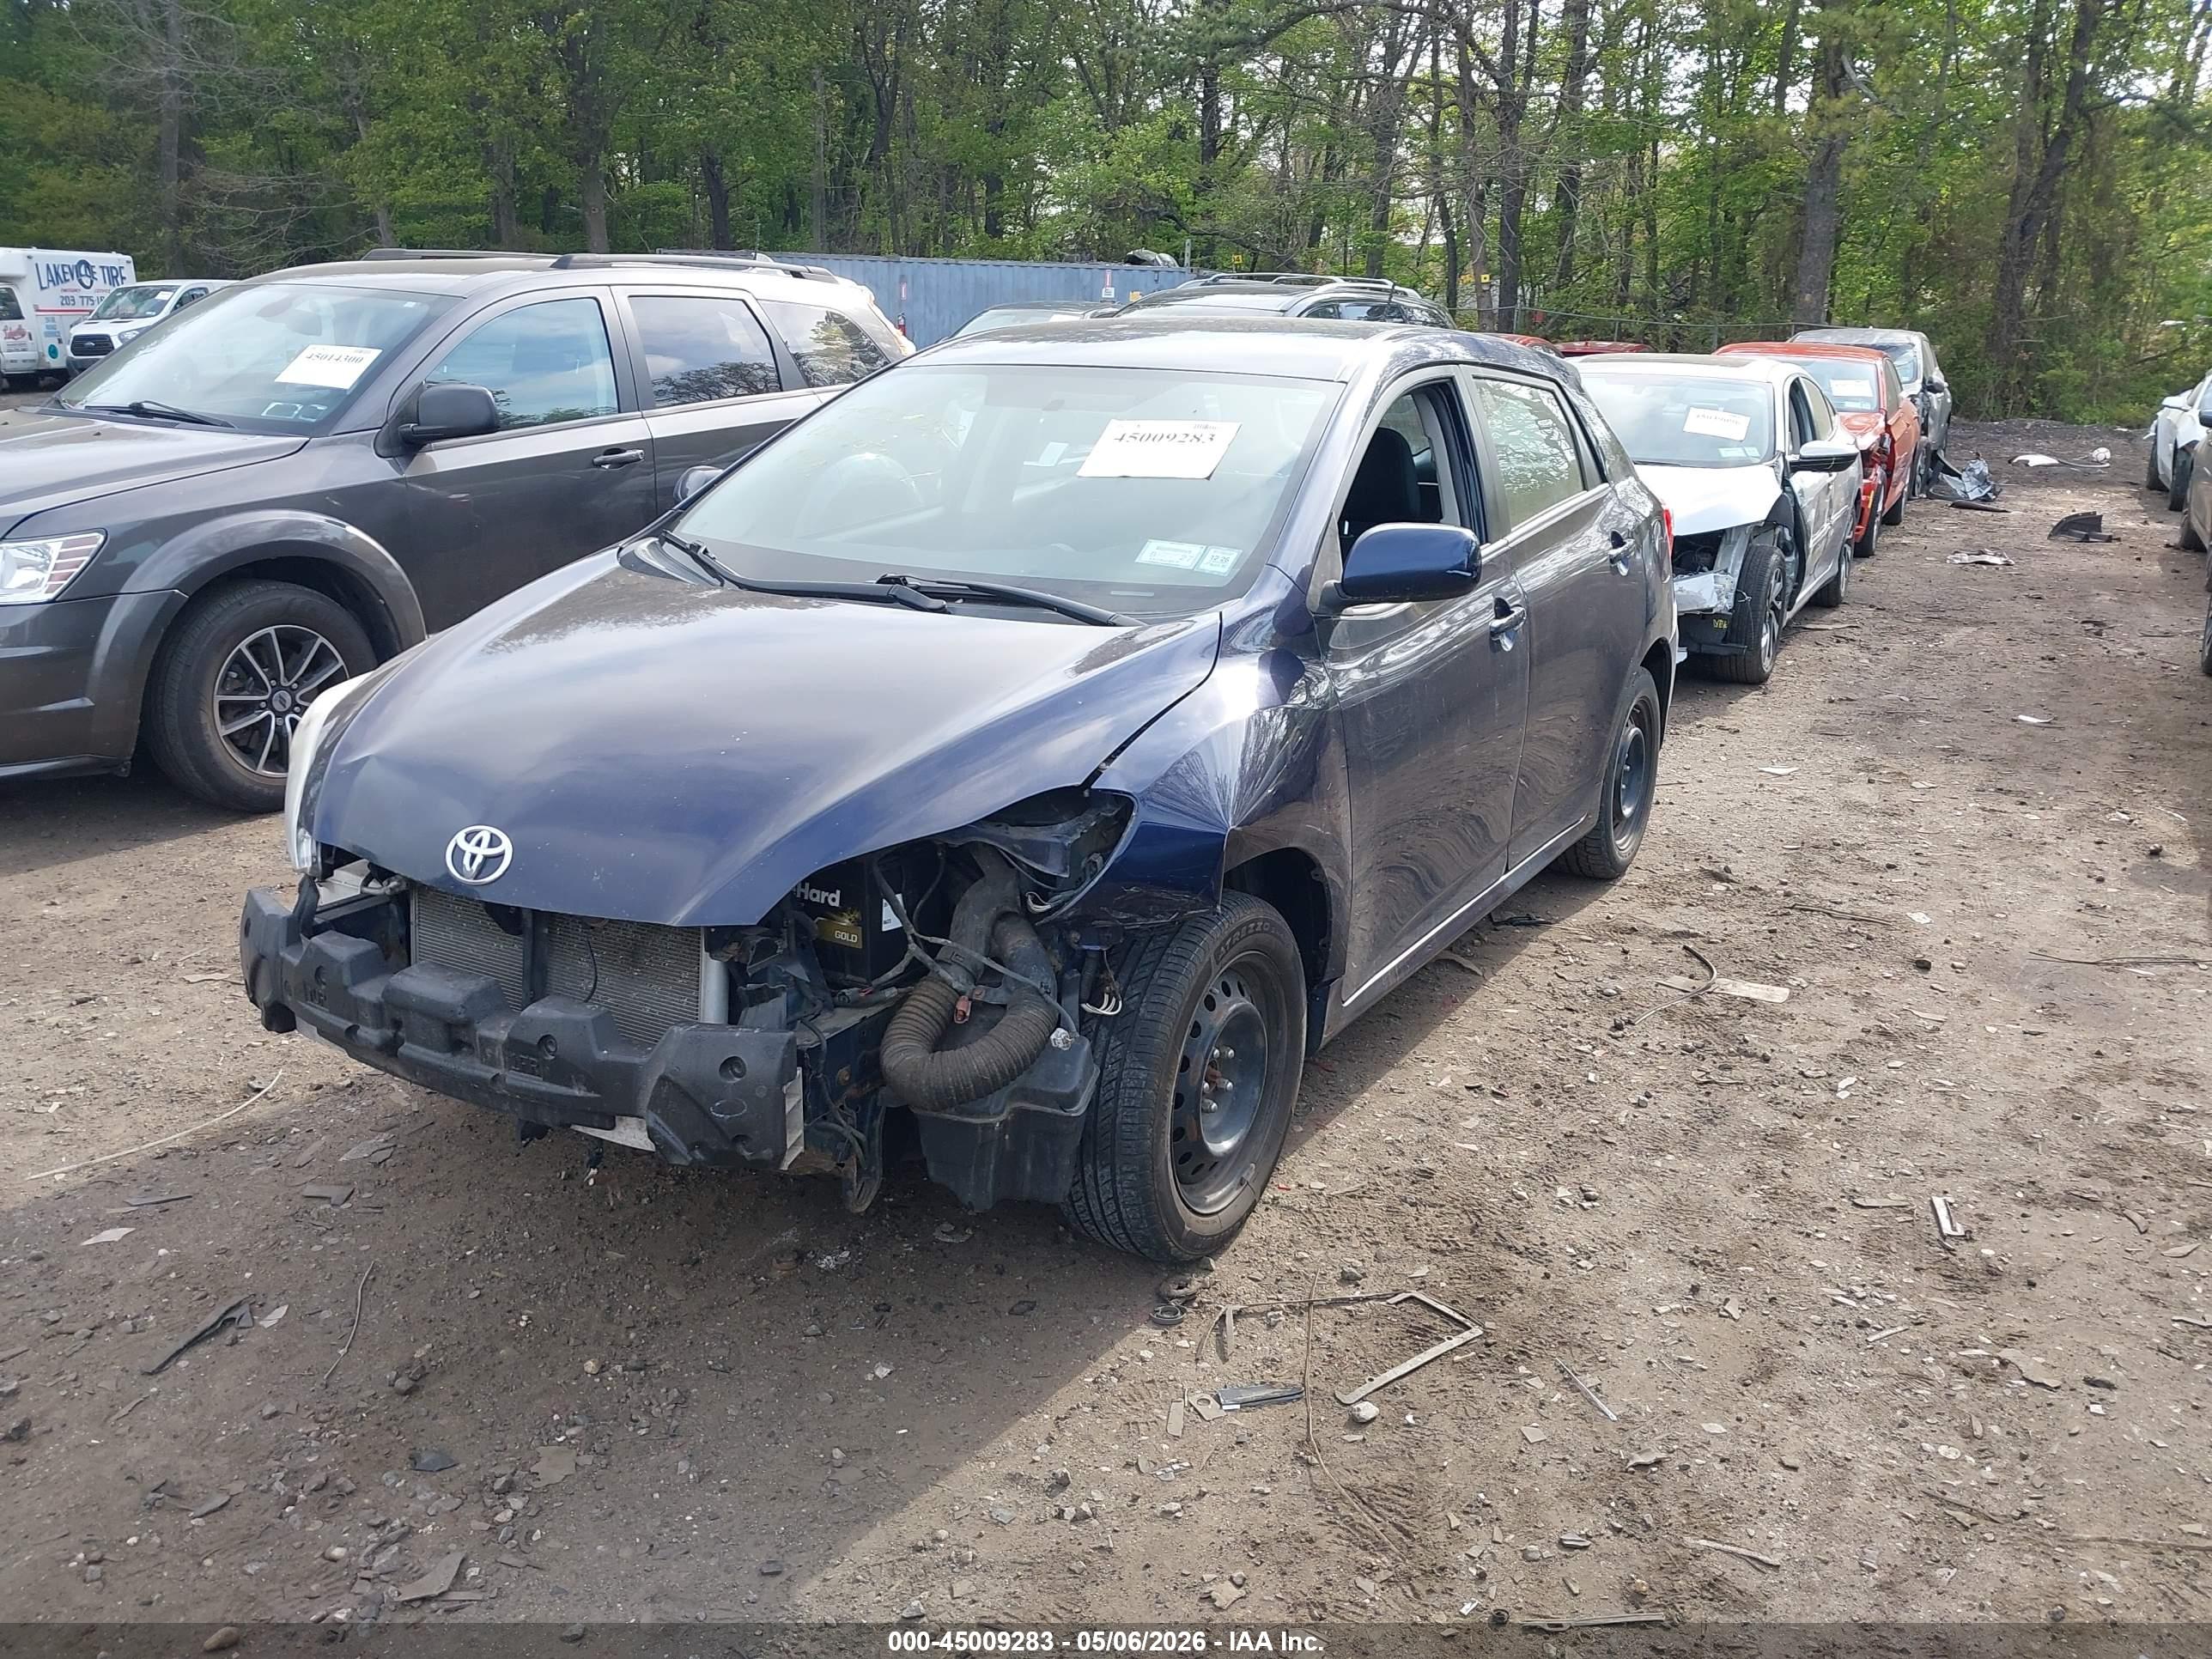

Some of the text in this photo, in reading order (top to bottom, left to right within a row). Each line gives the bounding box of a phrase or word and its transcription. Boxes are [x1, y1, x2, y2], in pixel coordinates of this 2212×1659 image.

[100, 265, 126, 287] TIRE
[60, 295, 76, 306] 203
[307, 353, 364, 364] 45014300
[1114, 432, 1216, 444] 45009283
[793, 883, 841, 907] Hard
[835, 930, 858, 943] GOLD
